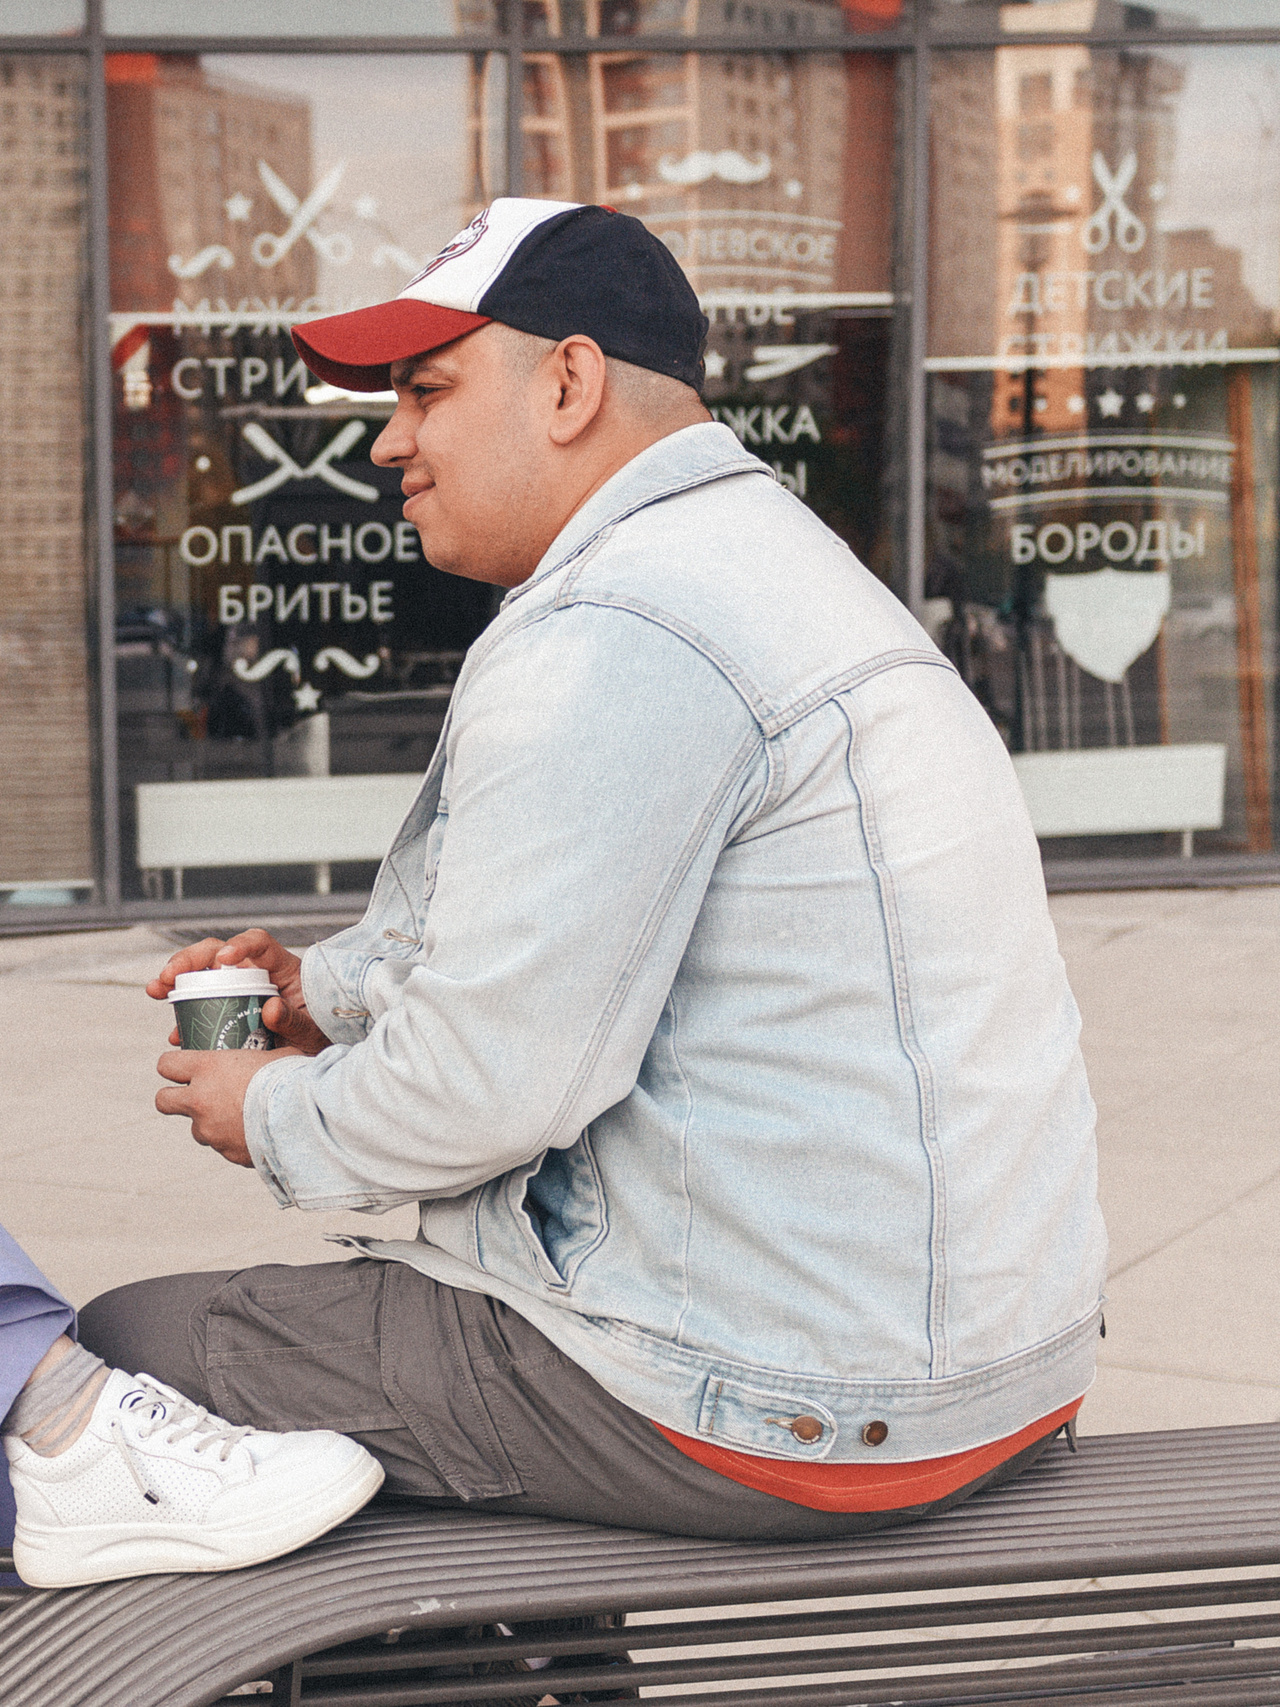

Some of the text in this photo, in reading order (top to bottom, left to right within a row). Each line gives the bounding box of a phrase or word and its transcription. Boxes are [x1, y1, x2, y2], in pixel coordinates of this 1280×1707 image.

[663, 228, 836, 266] ОЛЕВСКОЕ
[1009, 268, 1215, 316] ДЕТСКИЕ
[171, 357, 310, 400] СТРИ
[981, 450, 1235, 488] МОДЕЛИРОВАНИЕ
[179, 521, 420, 566] ОПАСНОЕ
[1010, 520, 1206, 565] БОРОДЫ
[218, 580, 396, 625] БРИТЬЕ
